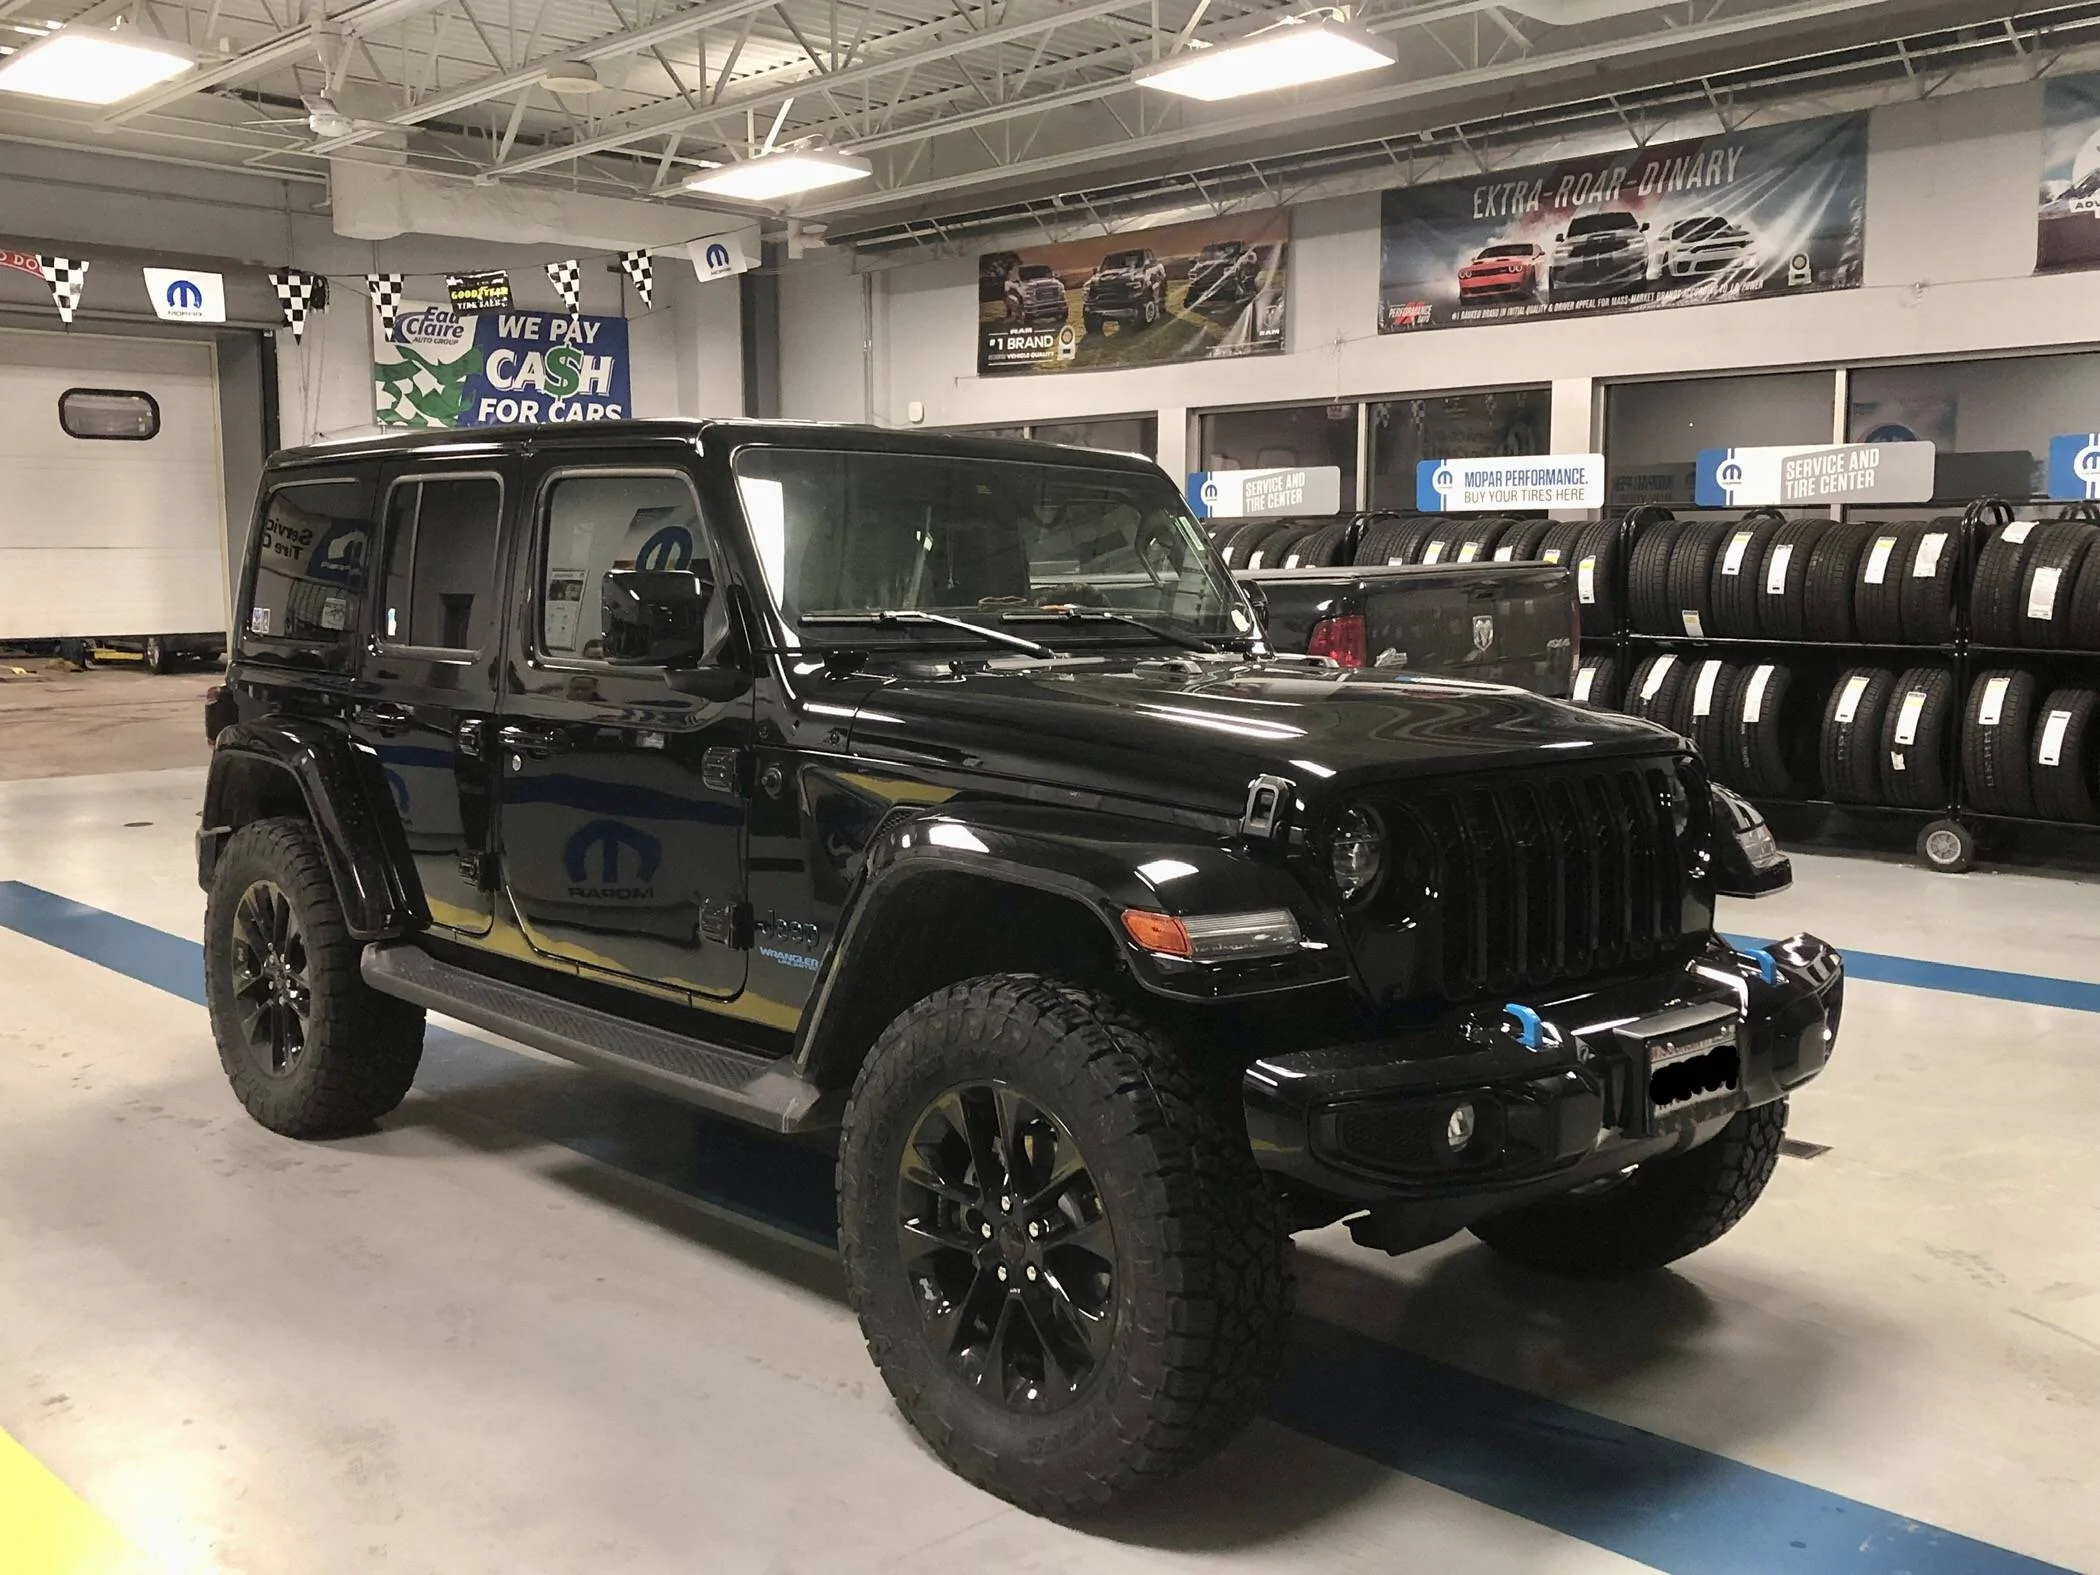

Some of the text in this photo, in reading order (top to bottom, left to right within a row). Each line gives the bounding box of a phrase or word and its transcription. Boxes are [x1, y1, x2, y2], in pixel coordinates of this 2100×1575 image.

[1473, 147, 1744, 219] EXTRA-ROAR-DINARY
[1597, 298, 1610, 307] FOR
[424, 306, 459, 324] Eau
[406, 317, 464, 339] Claire
[499, 315, 601, 344] WE PAY
[1007, 335, 1054, 350] BRAND
[477, 398, 623, 424] FOR CARS
[1785, 448, 1880, 480] SERVICE AND
[1245, 471, 1306, 497] SERVICE AND
[1464, 467, 1589, 488] MOPAR PERFORMANCE.
[1786, 469, 1875, 499] TIRE CENTER
[1246, 489, 1303, 513] TIRE CENTER
[1464, 488, 1585, 504] BUY YOUR TIRES HERE
[760, 946, 819, 968] WRANGLER
